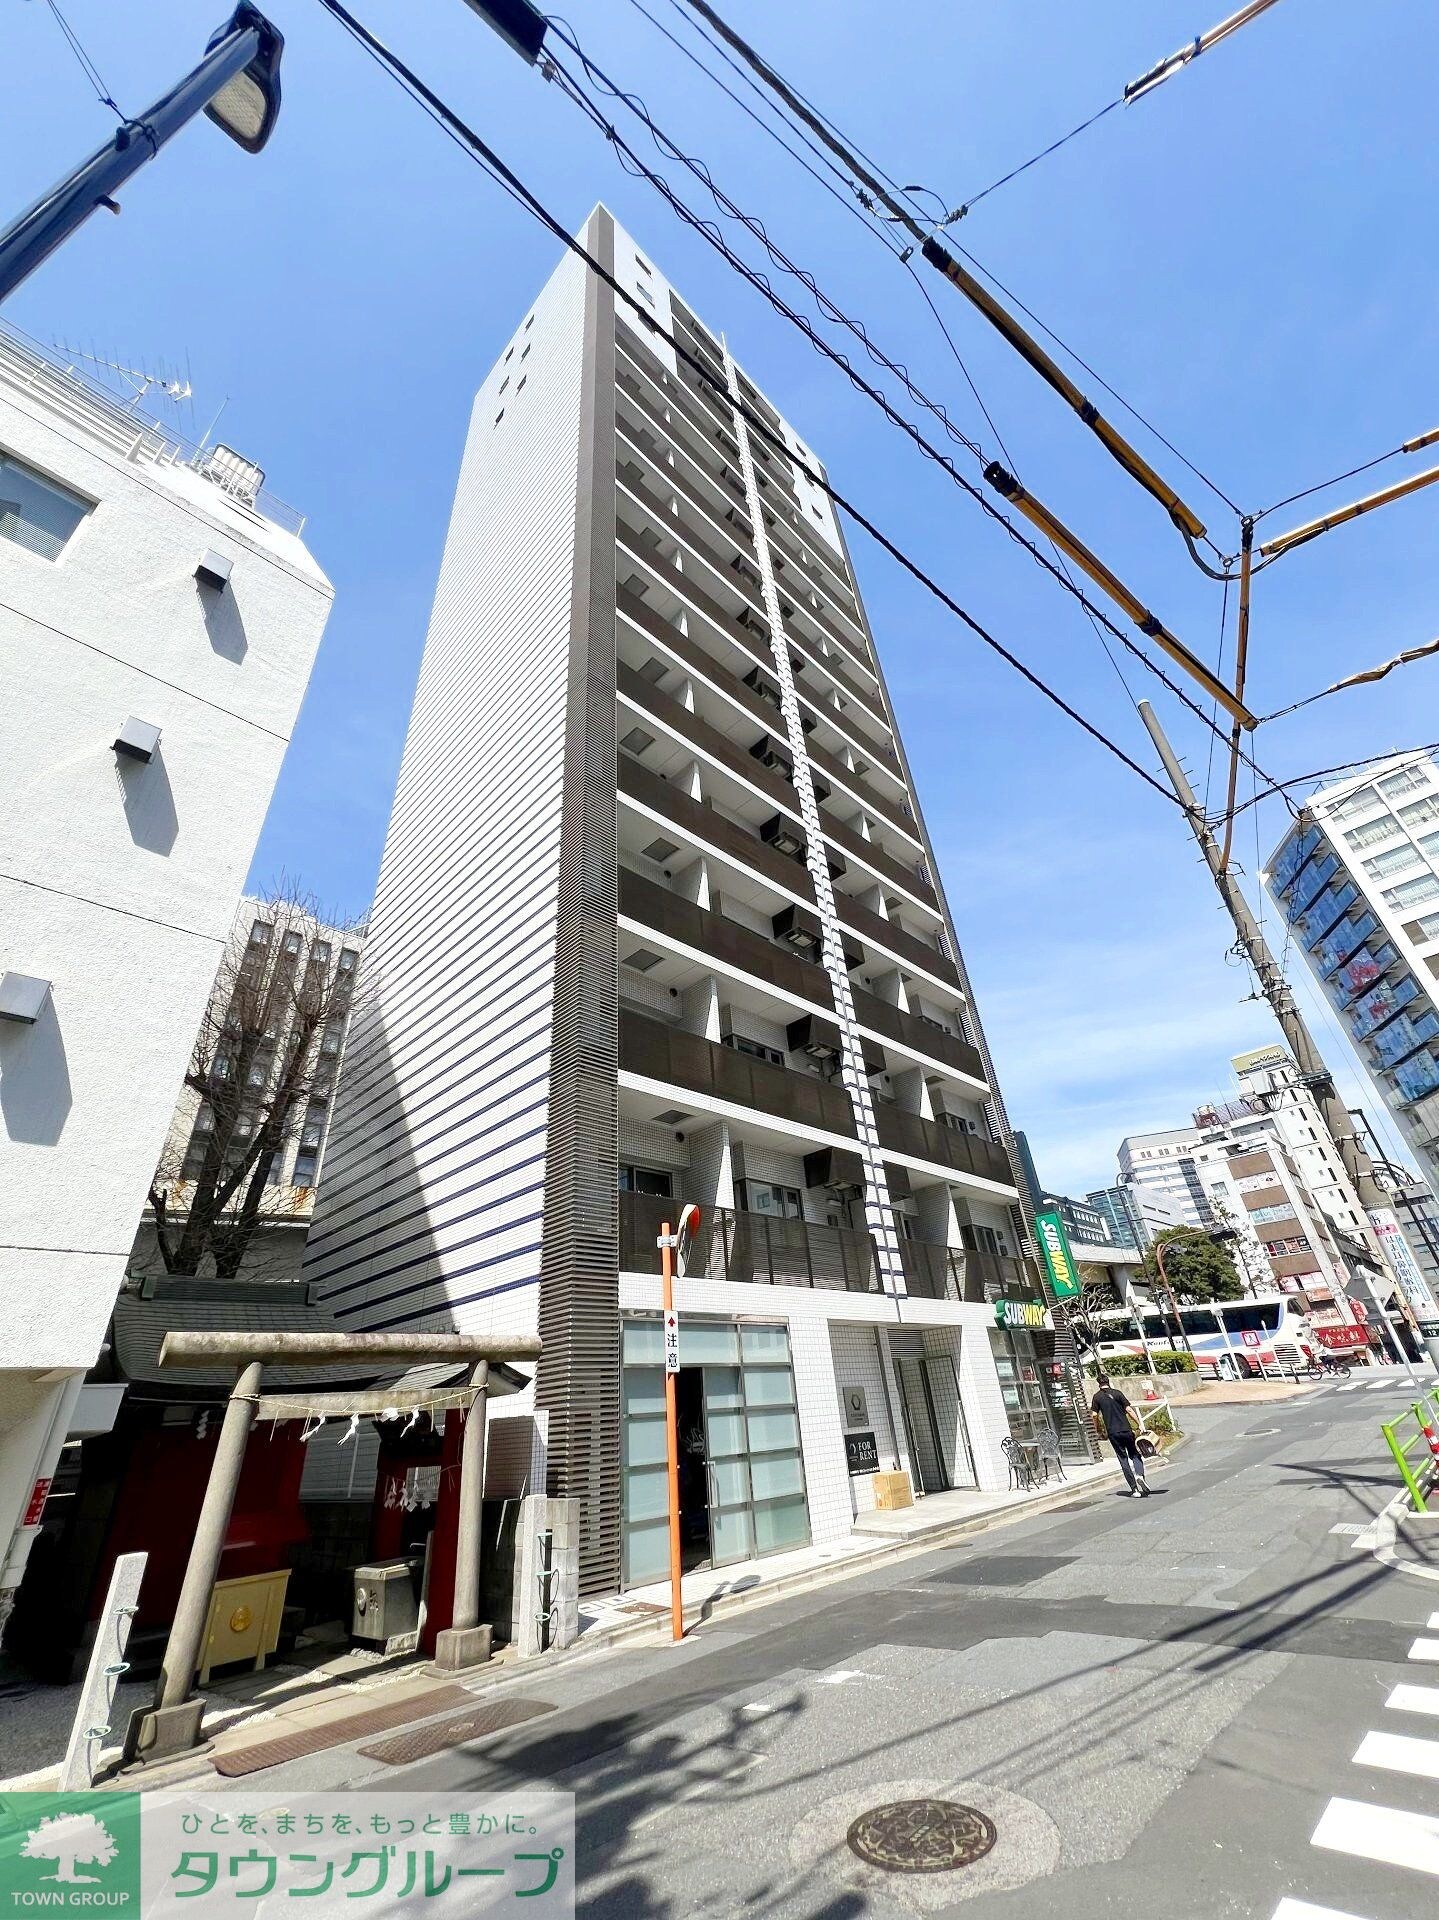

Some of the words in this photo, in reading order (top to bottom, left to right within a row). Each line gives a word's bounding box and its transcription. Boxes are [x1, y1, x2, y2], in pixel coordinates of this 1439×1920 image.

[1040, 1218, 1074, 1290] SUBWAY
[1004, 1302, 1046, 1326] SUBWAY
[667, 1335, 678, 1367] 注意
[857, 1441, 872, 1451] FOR
[860, 1449, 877, 1461] RENT
